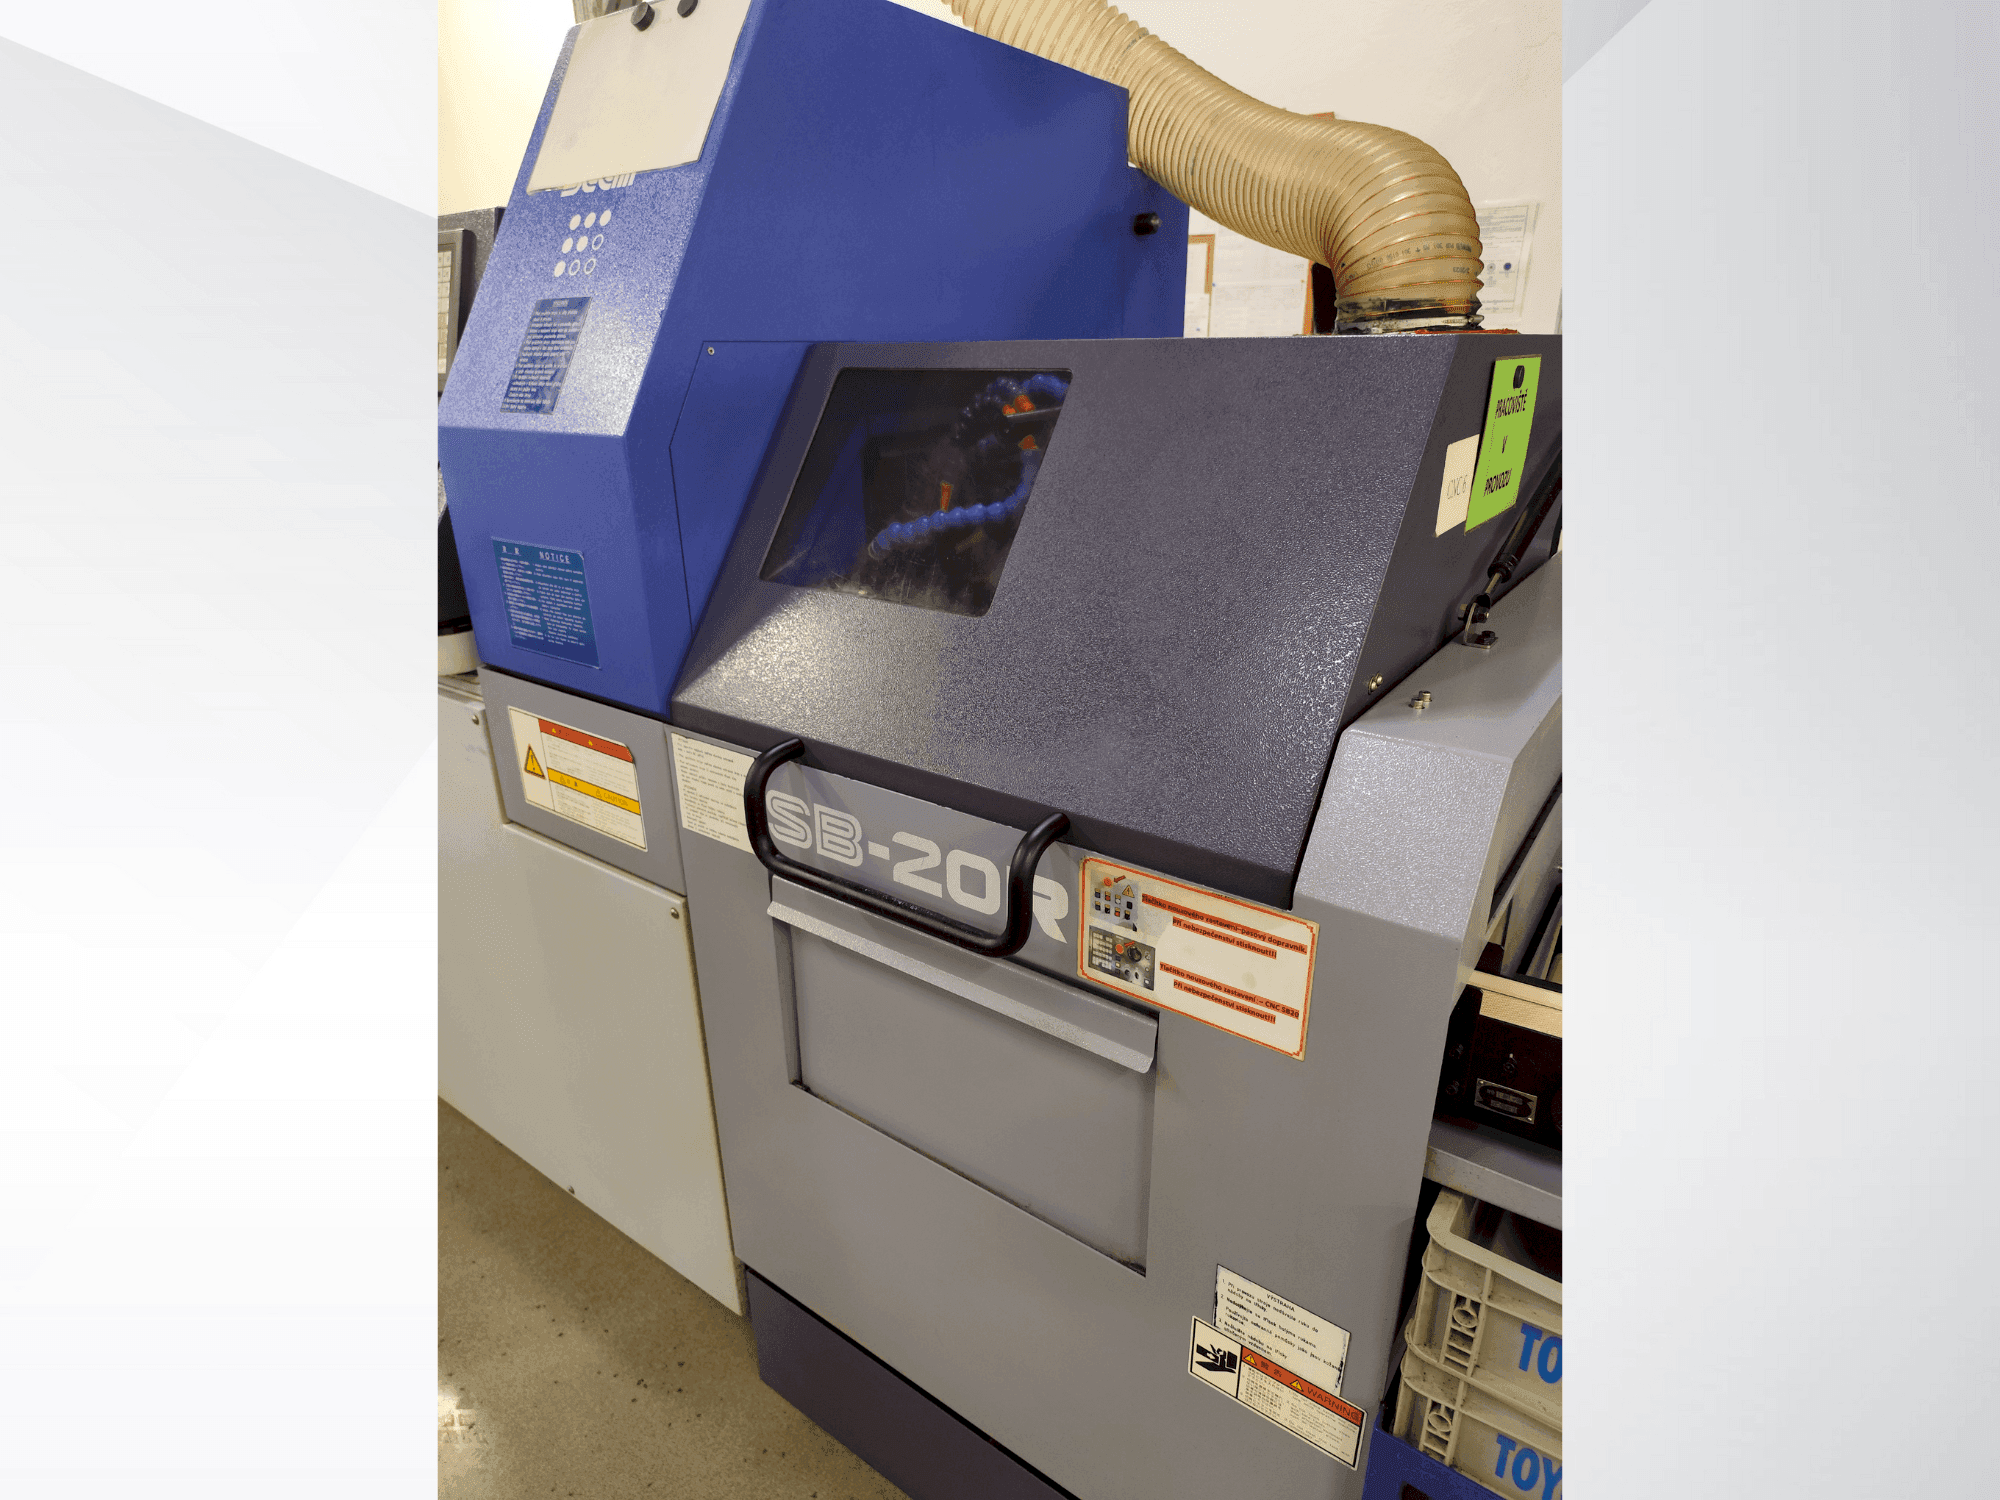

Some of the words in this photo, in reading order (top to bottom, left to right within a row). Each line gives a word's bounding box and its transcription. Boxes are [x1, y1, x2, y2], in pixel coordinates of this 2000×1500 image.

[1502, 435, 1508, 454] V
[1484, 468, 1512, 497] PROVOZU
[539, 551, 570, 563] NOTICE
[766, 789, 1068, 944] SB-20R
[1265, 1001, 1280, 1011] CNC
[1281, 1007, 1299, 1018] SB20
[1307, 1386, 1360, 1422] WARNING
